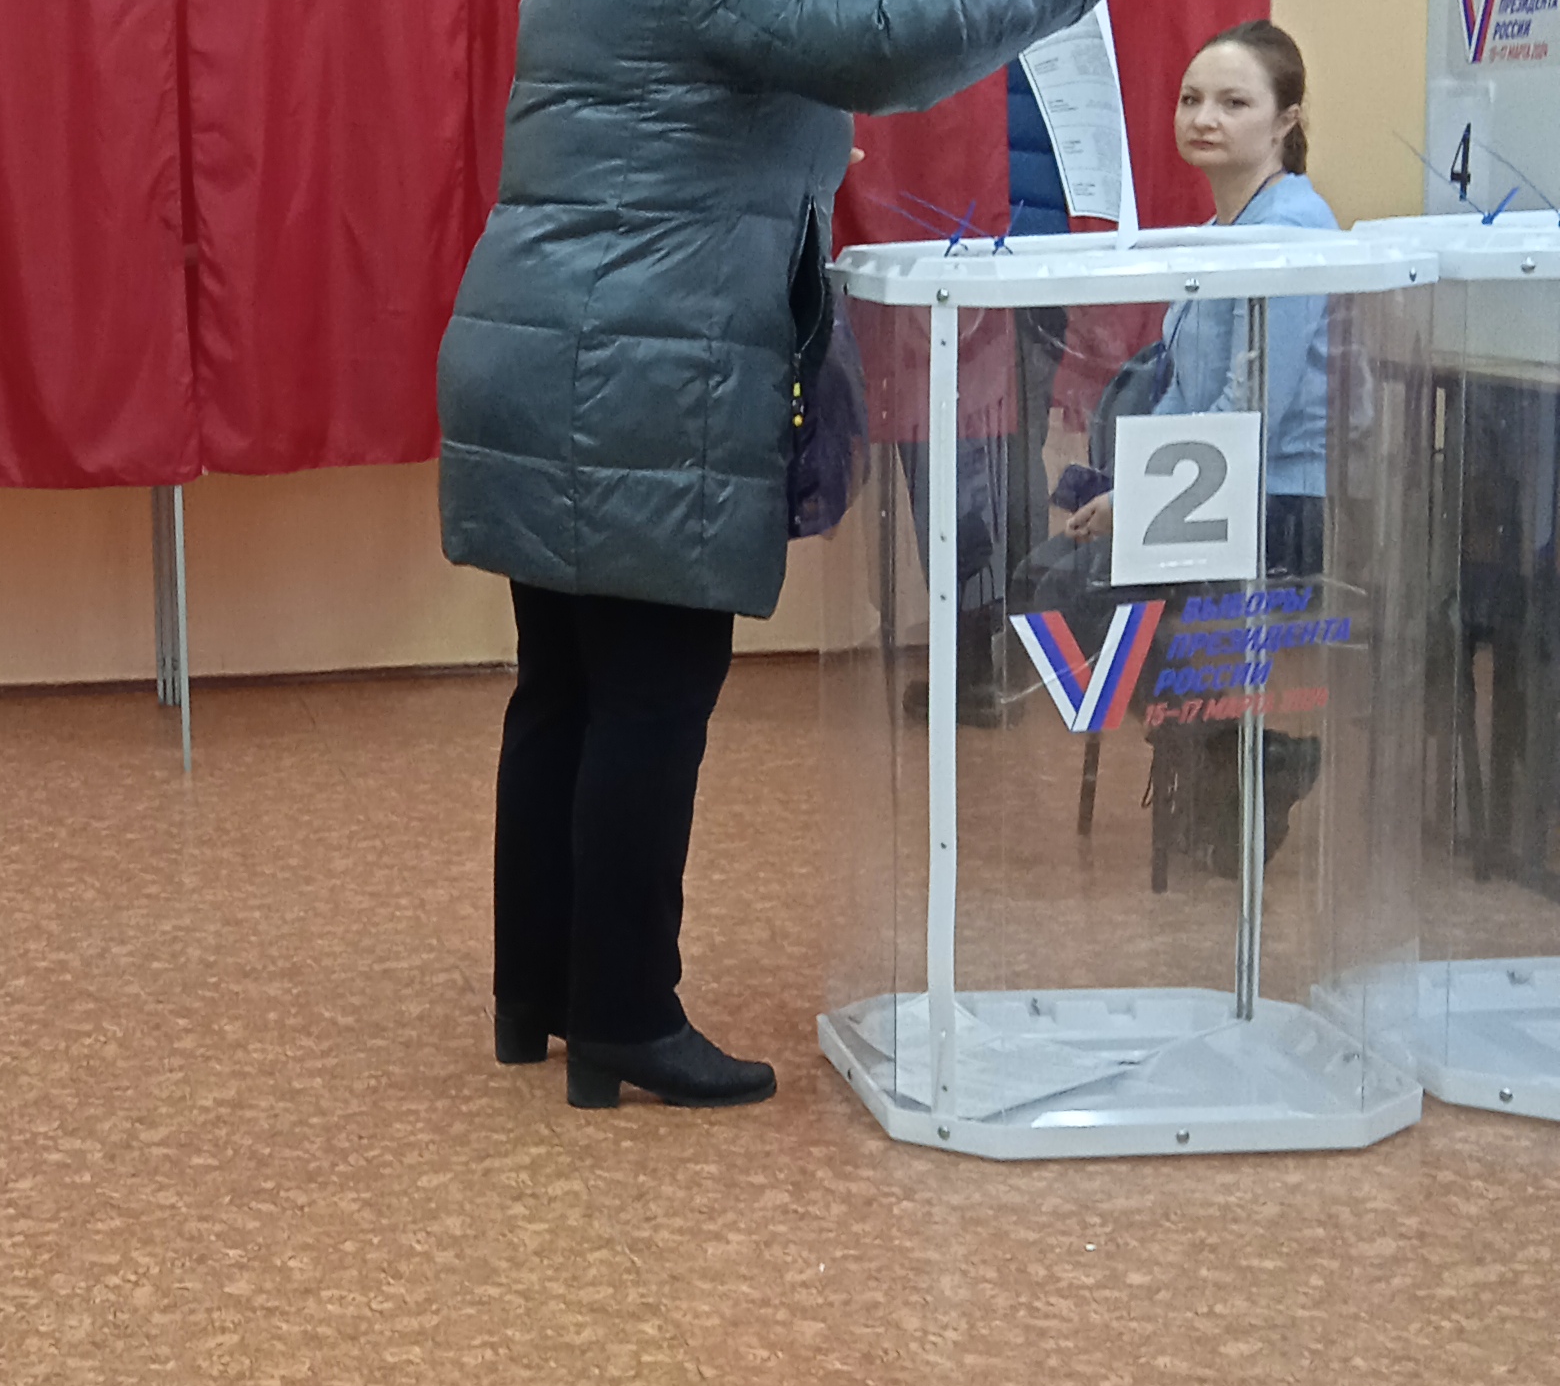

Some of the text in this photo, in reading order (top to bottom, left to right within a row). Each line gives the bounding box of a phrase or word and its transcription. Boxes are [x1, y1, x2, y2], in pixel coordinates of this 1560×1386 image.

[1492, 18, 1531, 41] РОССИИ
[1450, 122, 1472, 201] 4
[1142, 440, 1229, 546] 2
[1180, 586, 1313, 624] ВЫБОРЫ
[1166, 617, 1352, 661] ПРЕЗИДЕНТА
[1153, 658, 1274, 697] РОССИИ
